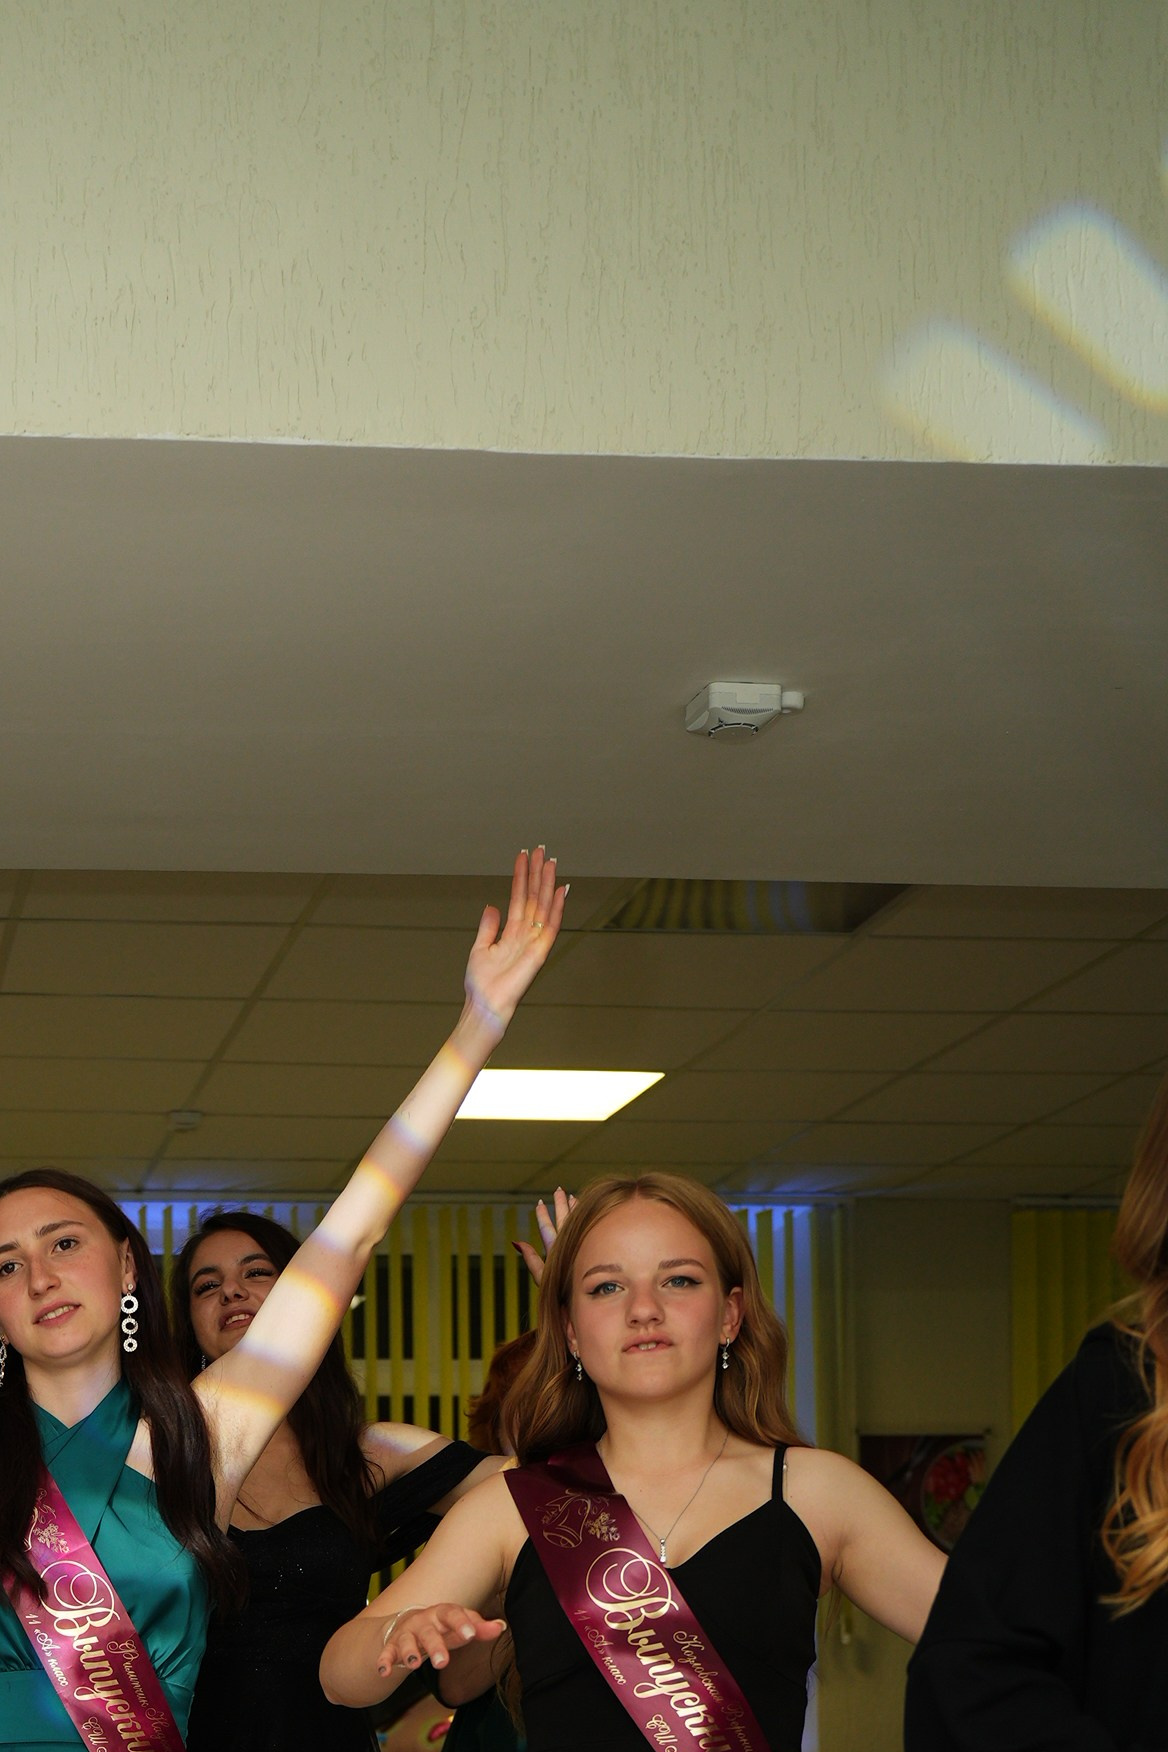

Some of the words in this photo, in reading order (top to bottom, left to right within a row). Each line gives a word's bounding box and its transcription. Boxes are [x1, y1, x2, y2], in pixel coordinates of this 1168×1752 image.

[25, 1613, 41, 1625] 11
[47, 1658, 69, 1687] класс
[107, 1639, 149, 1707] Филипчик
[573, 1609, 590, 1621] 11
[602, 1656, 627, 1686] класс
[673, 1631, 724, 1703] Козловская
